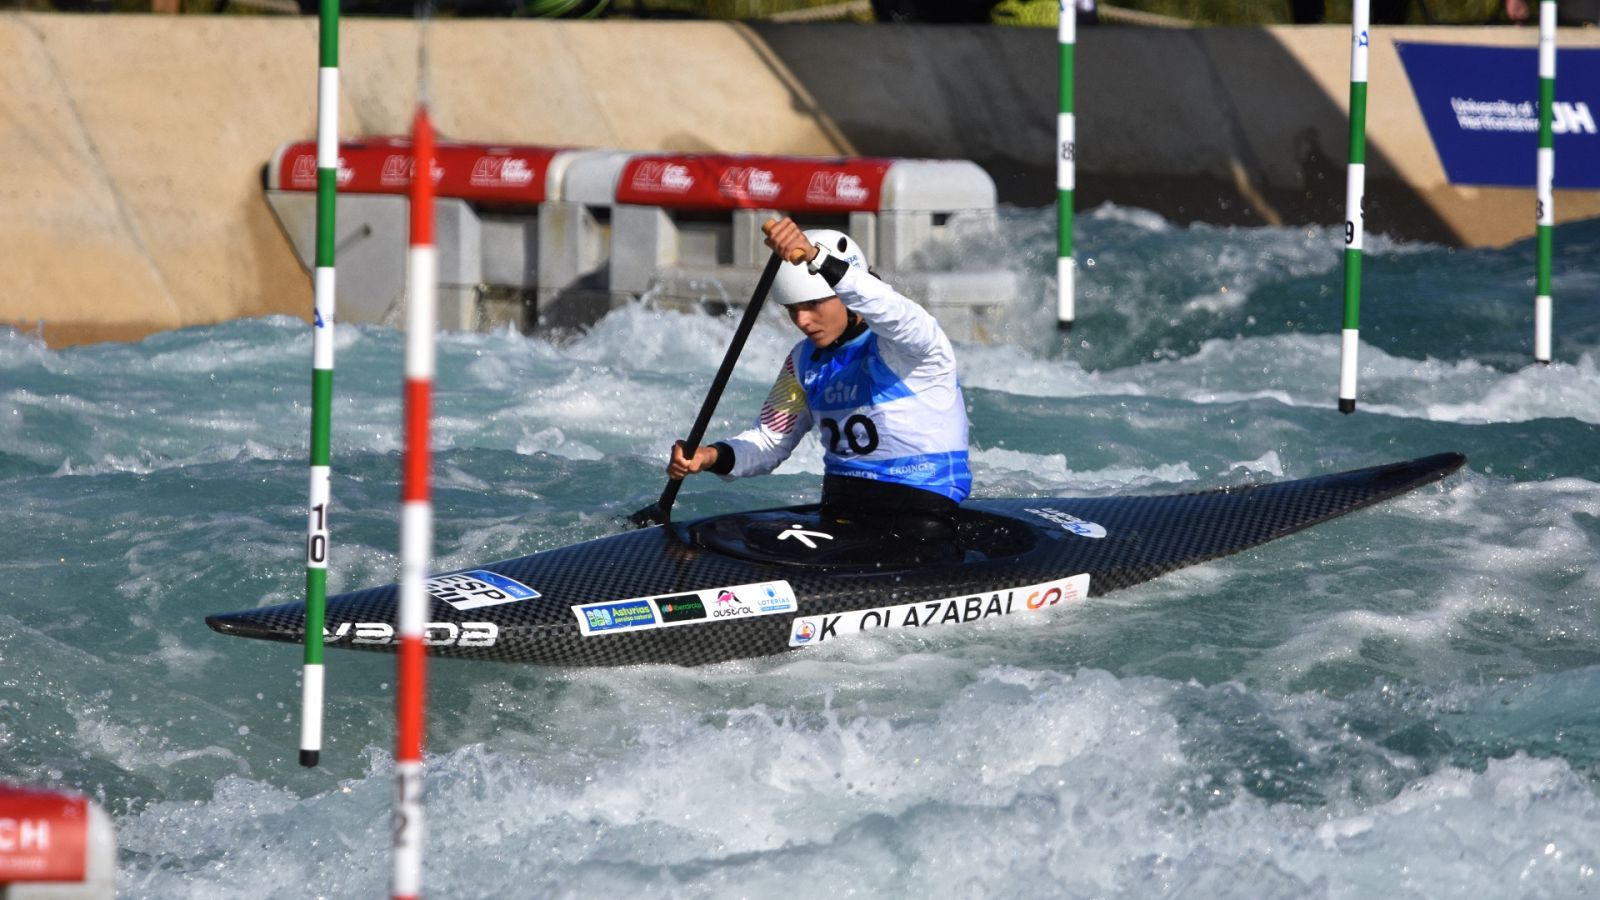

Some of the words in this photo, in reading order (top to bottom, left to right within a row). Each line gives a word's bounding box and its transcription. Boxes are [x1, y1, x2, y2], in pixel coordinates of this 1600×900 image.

[1345, 220, 1355, 245] 9
[825, 380, 858, 404] Gill
[820, 414, 879, 456] 20
[890, 462, 936, 476] ERDINGER
[310, 503, 326, 563] 10
[431, 575, 506, 600] ESP
[612, 605, 650, 617] Asturias
[713, 606, 754, 618] austral
